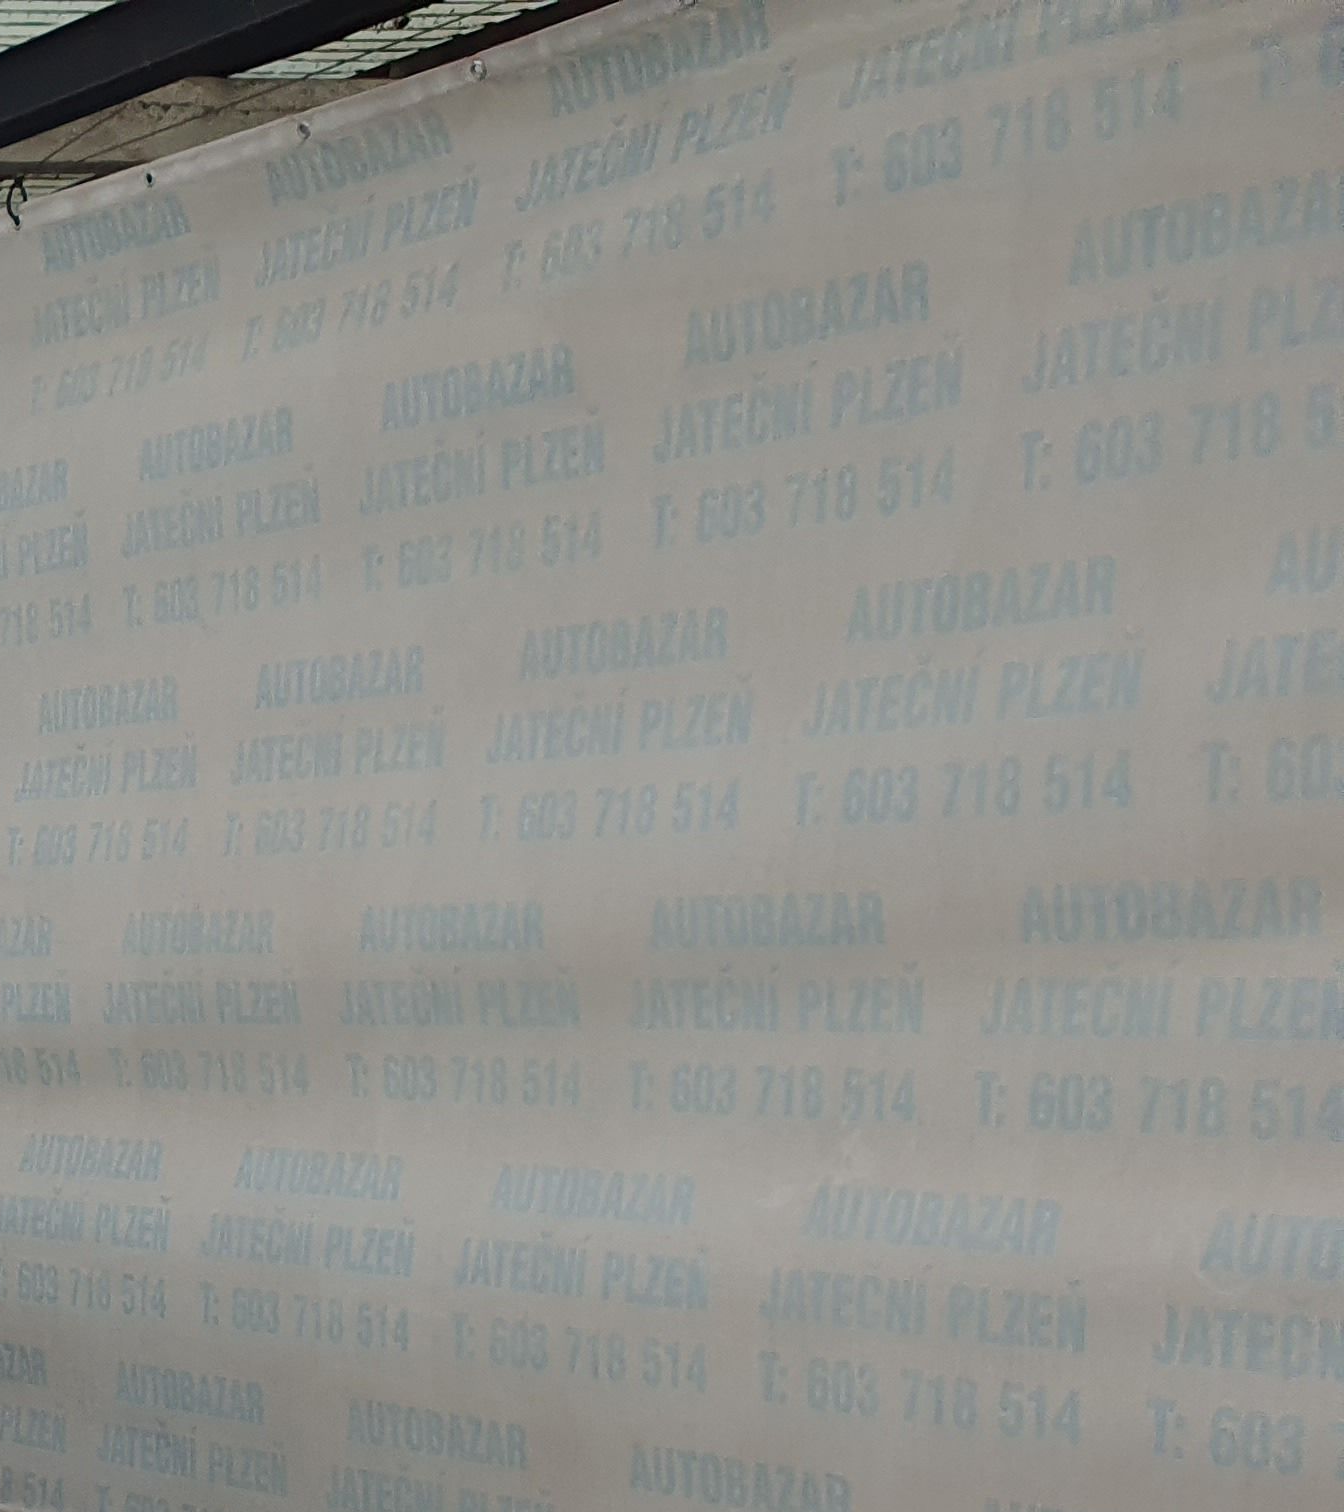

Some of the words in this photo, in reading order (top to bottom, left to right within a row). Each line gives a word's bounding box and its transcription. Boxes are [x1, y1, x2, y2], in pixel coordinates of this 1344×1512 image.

[549, 9, 772, 118] AUTOBAZAR
[264, 111, 454, 209] AUTOBAZAR
[882, 119, 963, 198] 603
[987, 91, 1070, 168] 718
[1095, 61, 1185, 144] 514
[543, 225, 602, 283] 603
[623, 201, 686, 258] 718
[701, 175, 777, 241] 514
[1068, 171, 1343, 288] AUTOBAZA
[340, 282, 390, 329] 718
[402, 265, 460, 320] 514
[685, 262, 931, 368] AUTOBAZAR
[382, 343, 577, 434] AUTOBAZAR
[141, 407, 293, 483] AUTOBAZAR
[1074, 415, 1163, 492] 603
[1192, 392, 1281, 464] 718
[696, 481, 768, 545] 603
[789, 466, 859, 527] 718
[879, 450, 954, 520] 514
[474, 520, 525, 575] 718
[542, 512, 601, 569] 514
[216, 568, 260, 614] 718
[272, 564, 322, 609] 514
[847, 557, 1118, 645] AUTOBAZAR
[520, 608, 729, 681] AUTOBAZAR
[39, 677, 180, 735] AUTOBAZAR
[255, 647, 426, 711] AUTOBAZAR
[518, 792, 577, 845] 603
[594, 785, 657, 839] 718
[673, 781, 740, 835] 514
[840, 769, 920, 828] 603
[943, 758, 1021, 820] 718
[1045, 753, 1134, 817] 514
[90, 823, 131, 864] 718
[143, 819, 189, 862] 514
[319, 808, 371, 856] 718
[382, 801, 437, 849] 514
[359, 901, 545, 955] AUTOBAZAR
[648, 894, 887, 952] AUTOBAZAR
[1019, 879, 1322, 946] AUTOBAZAR
[202, 1053, 248, 1094] 718
[260, 1056, 309, 1098] 514
[383, 1059, 440, 1105] 603
[454, 1058, 508, 1106] 718
[523, 1060, 581, 1107] 514
[669, 1064, 738, 1116] 603
[757, 1065, 826, 1121] 718
[842, 1071, 920, 1128] 514
[1028, 1074, 1114, 1136] 603
[1141, 1079, 1229, 1139] 718
[1252, 1081, 1343, 1144] 514
[20, 1136, 164, 1184] AUTOBAZAR
[234, 1150, 403, 1203] AUTOBAZAR
[493, 1167, 696, 1227] AUTOBAZAR
[803, 1184, 1063, 1258] AUTOBAZAR
[73, 1272, 112, 1312] 718
[123, 1274, 168, 1321] 514
[295, 1297, 345, 1346] 718
[356, 1304, 410, 1354] 514
[569, 1329, 627, 1384] 718
[642, 1341, 707, 1393] 514
[117, 1366, 265, 1427] AUTOBAZAR
[808, 1359, 880, 1419] 603
[905, 1375, 979, 1435] 718
[999, 1383, 1082, 1449] 514
[348, 1402, 529, 1470] AUTOBAZAR
[1209, 1409, 1305, 1480] 603
